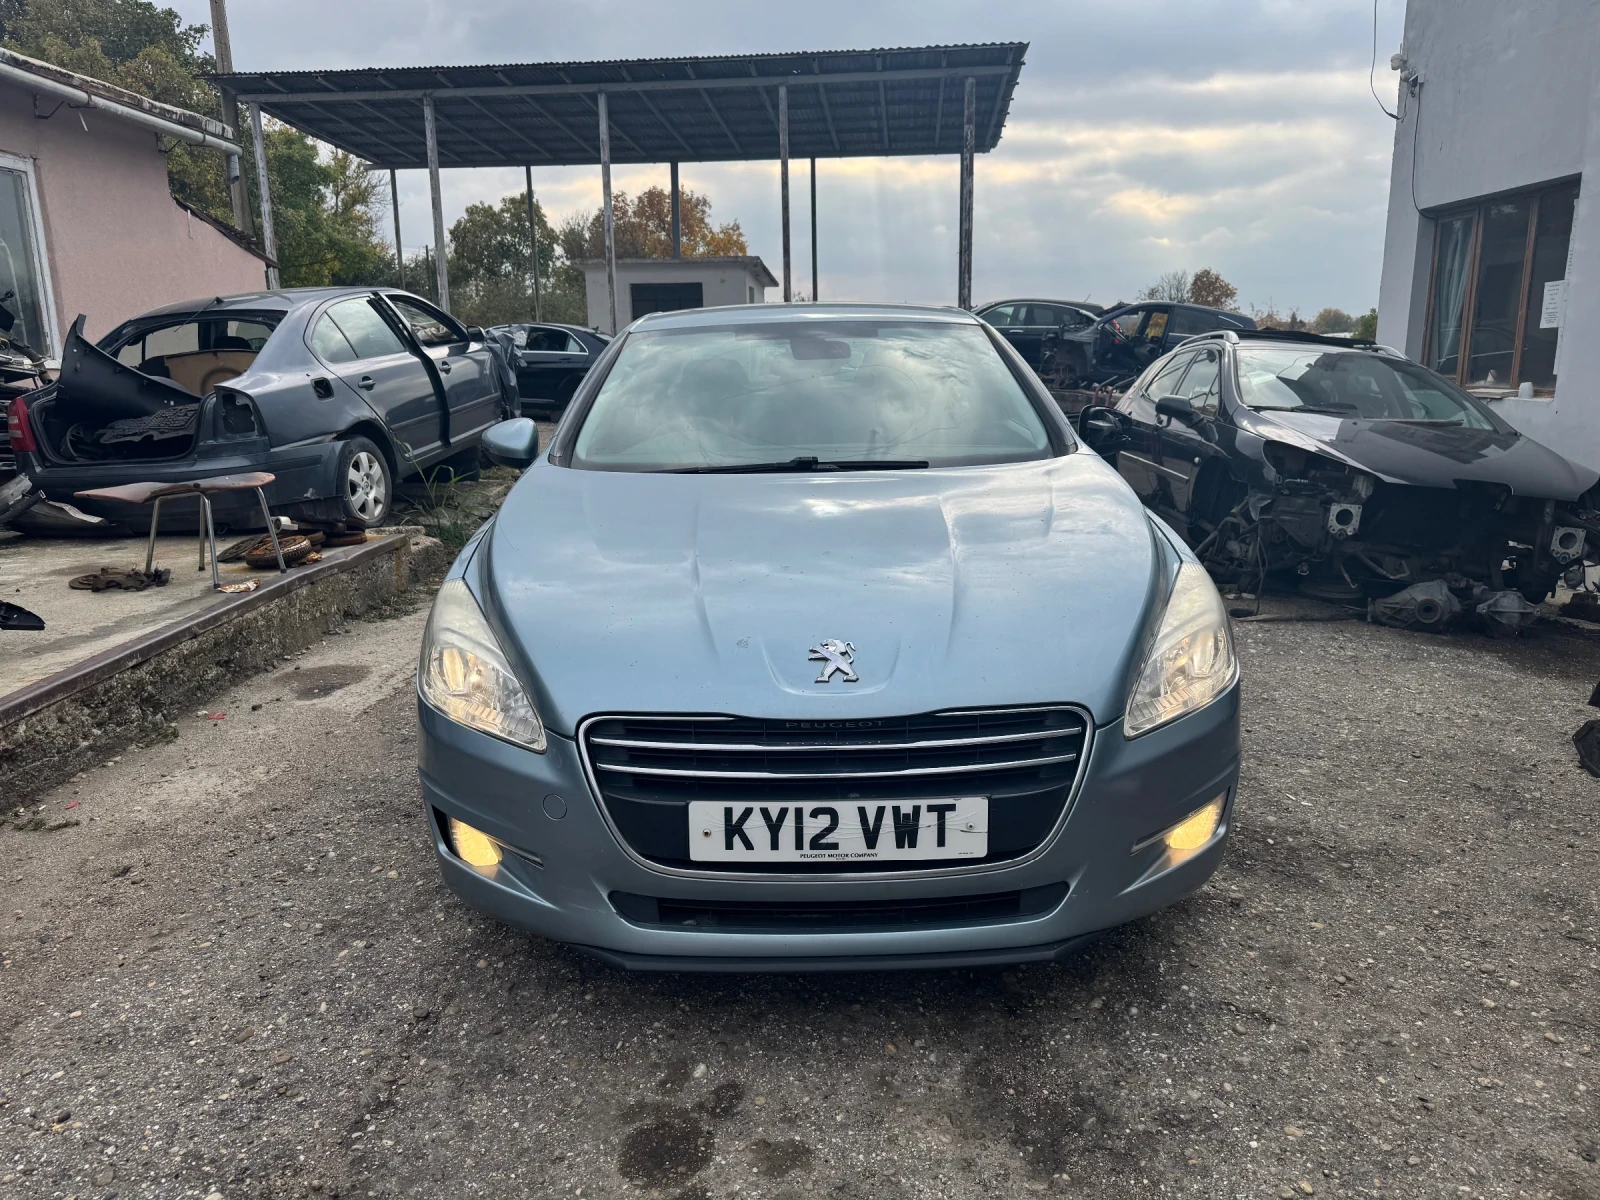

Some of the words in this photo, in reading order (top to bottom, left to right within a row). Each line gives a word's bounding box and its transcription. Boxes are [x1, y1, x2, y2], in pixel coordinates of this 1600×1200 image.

[785, 720, 885, 729] PEUGEOT
[723, 806, 840, 851] KY12
[857, 804, 957, 850] VWT
